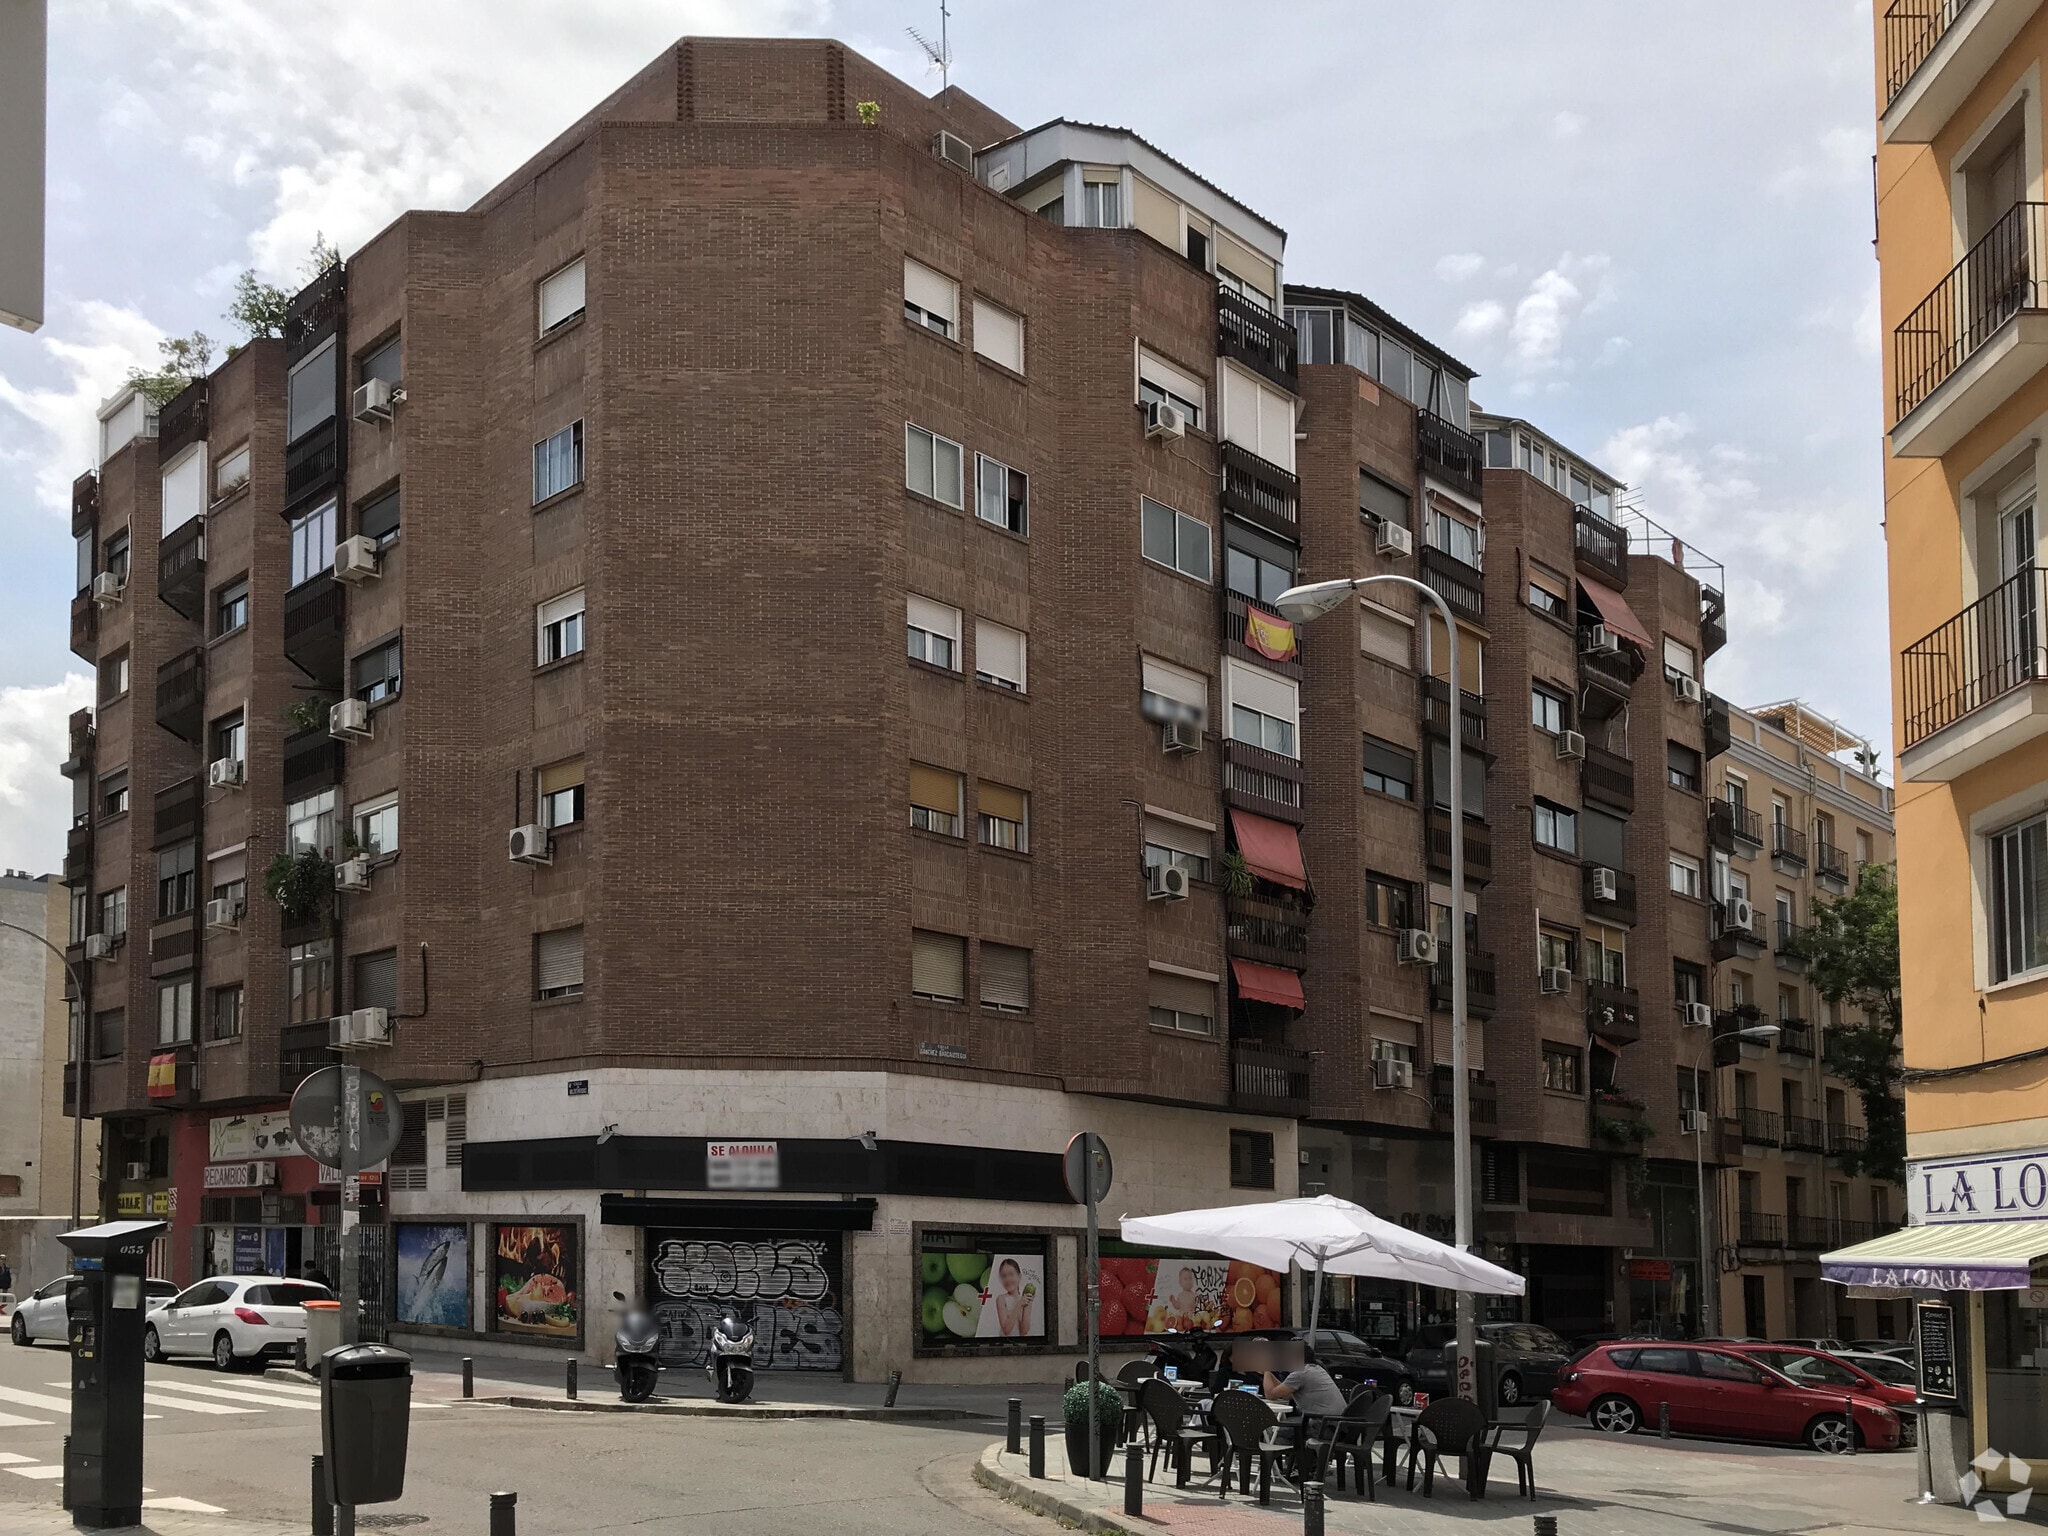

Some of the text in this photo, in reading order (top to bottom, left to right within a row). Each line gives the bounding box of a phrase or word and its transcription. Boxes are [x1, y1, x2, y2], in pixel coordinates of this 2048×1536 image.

[711, 1145, 725, 1156] SE
[205, 1167, 247, 1186] RECAMBIOS
[1923, 1170, 1980, 1214] LA
[1871, 1267, 1972, 1289] LA LONJA
